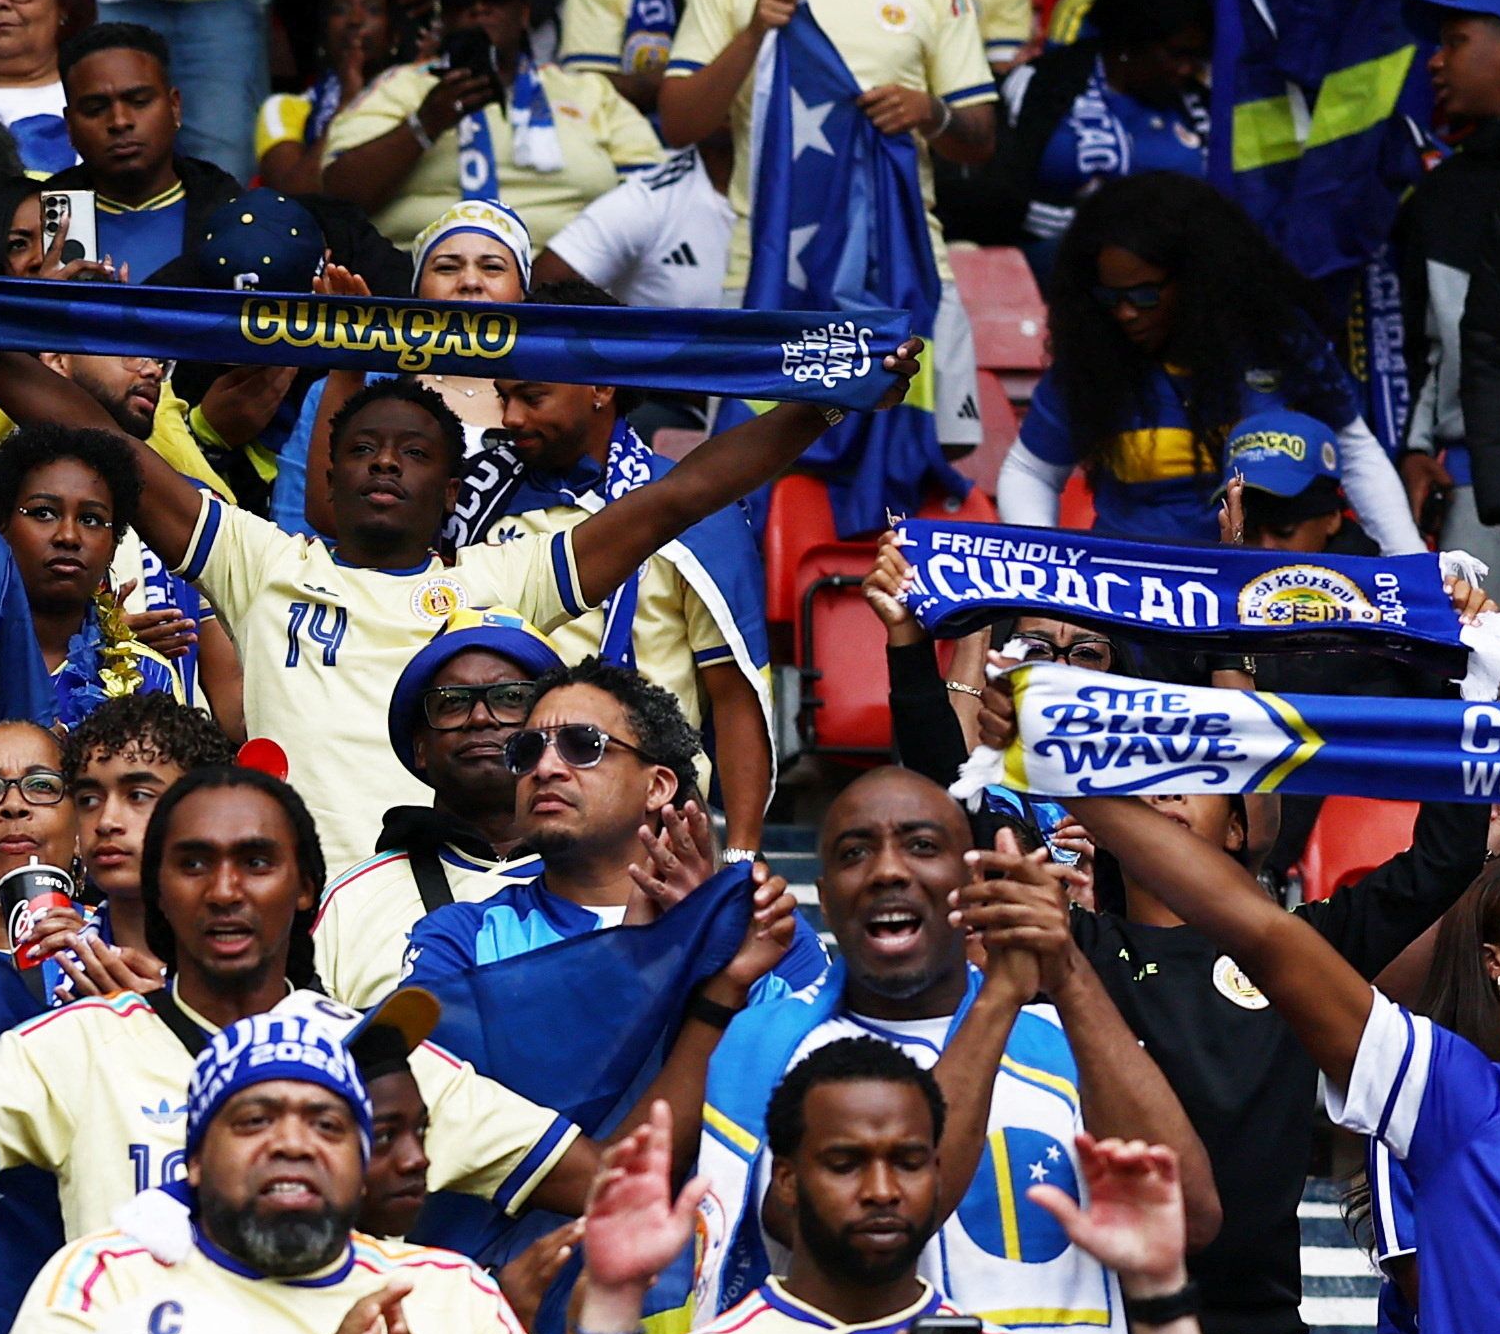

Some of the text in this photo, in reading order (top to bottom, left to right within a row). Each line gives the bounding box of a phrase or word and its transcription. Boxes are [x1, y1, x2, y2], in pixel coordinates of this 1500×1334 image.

[240, 295, 518, 373] CURAÇAO
[821, 320, 858, 389] WAVE
[931, 531, 1087, 567] FRIENDLY
[285, 599, 347, 669] 14
[1076, 686, 1192, 714] THE
[1044, 703, 1234, 738] BLUE
[1036, 732, 1249, 774] WAVE
[34, 875, 63, 888] zero
